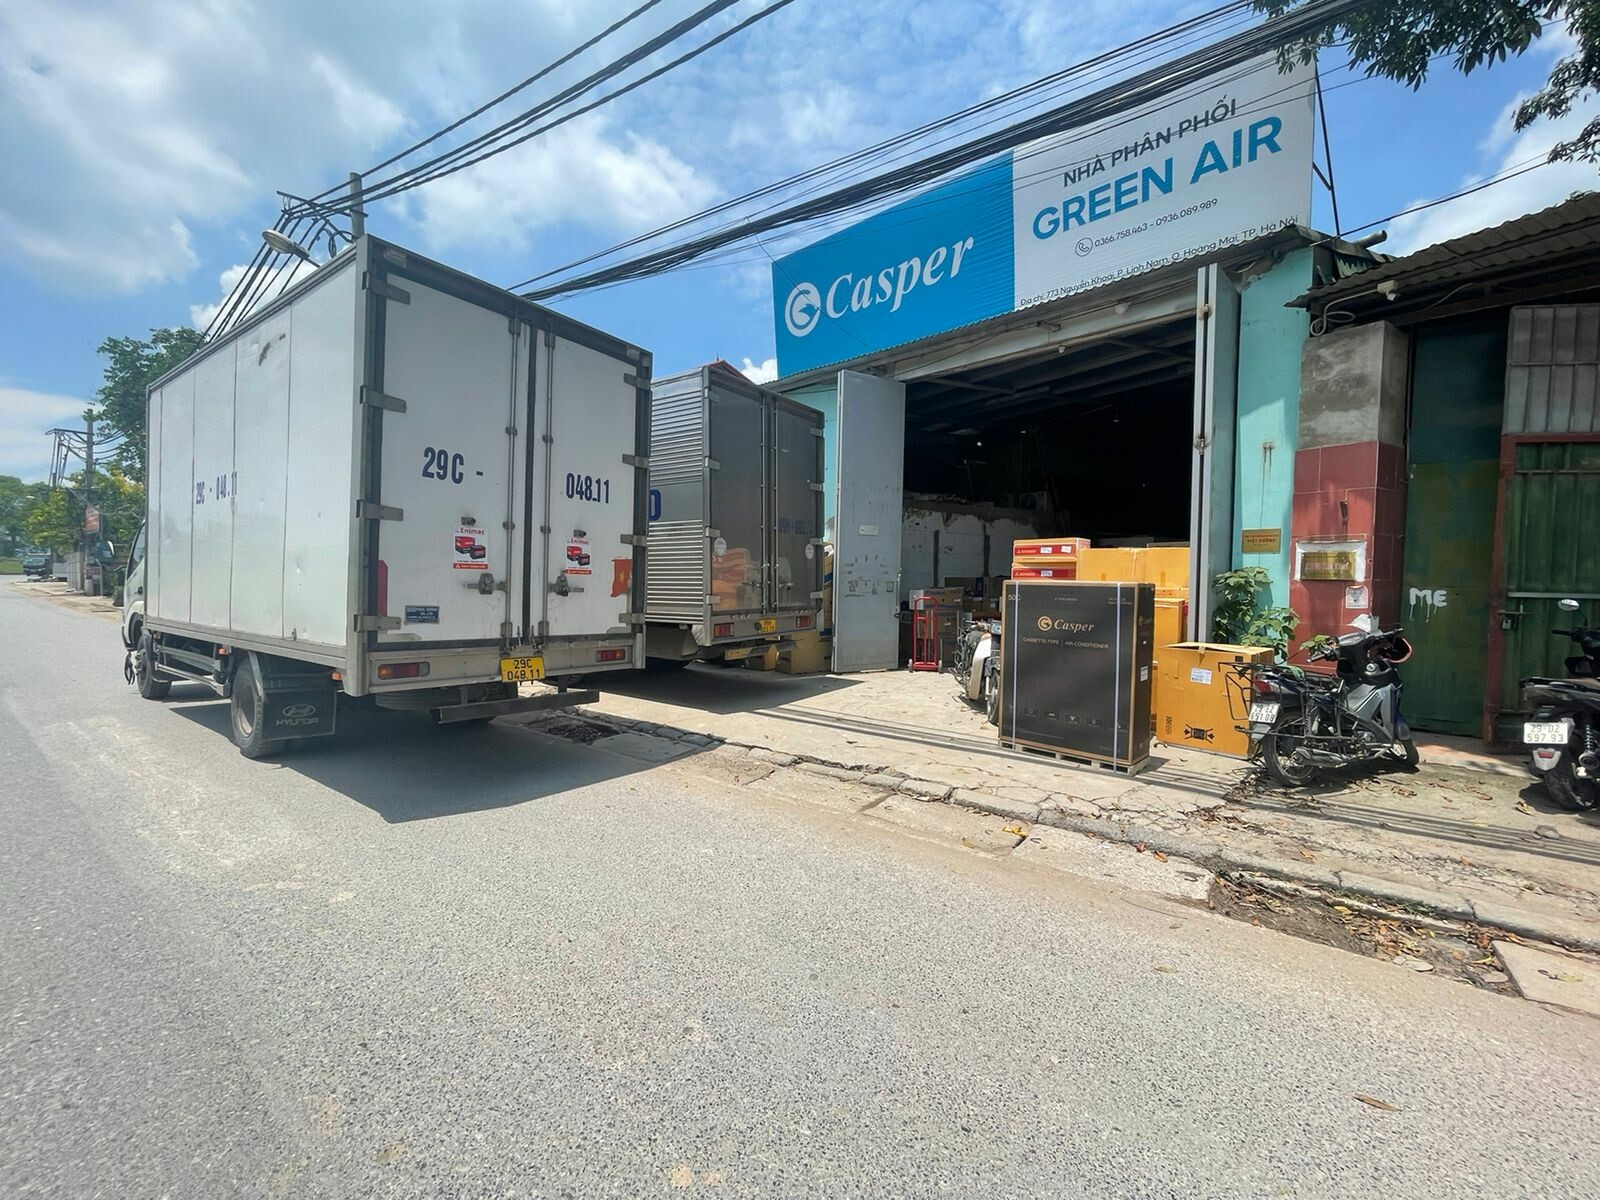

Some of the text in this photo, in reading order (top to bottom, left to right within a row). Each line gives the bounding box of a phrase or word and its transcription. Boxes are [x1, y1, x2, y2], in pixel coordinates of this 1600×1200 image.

[1063, 94, 1236, 187] NHÀ PHÂN PHỐI
[1032, 116, 1283, 240] GREEN AIR
[1094, 222, 1148, 247] 0366.758.463
[1155, 198, 1218, 226] 0936.089.989
[826, 236, 975, 319] Casper
[1046, 290, 1059, 299] 773
[422, 446, 465, 484] 29C
[566, 472, 610, 504] 048.11
[1409, 587, 1448, 609] ME
[1054, 619, 1095, 633] Casper
[507, 669, 540, 680] 048.11
[513, 658, 533, 669] 29C
